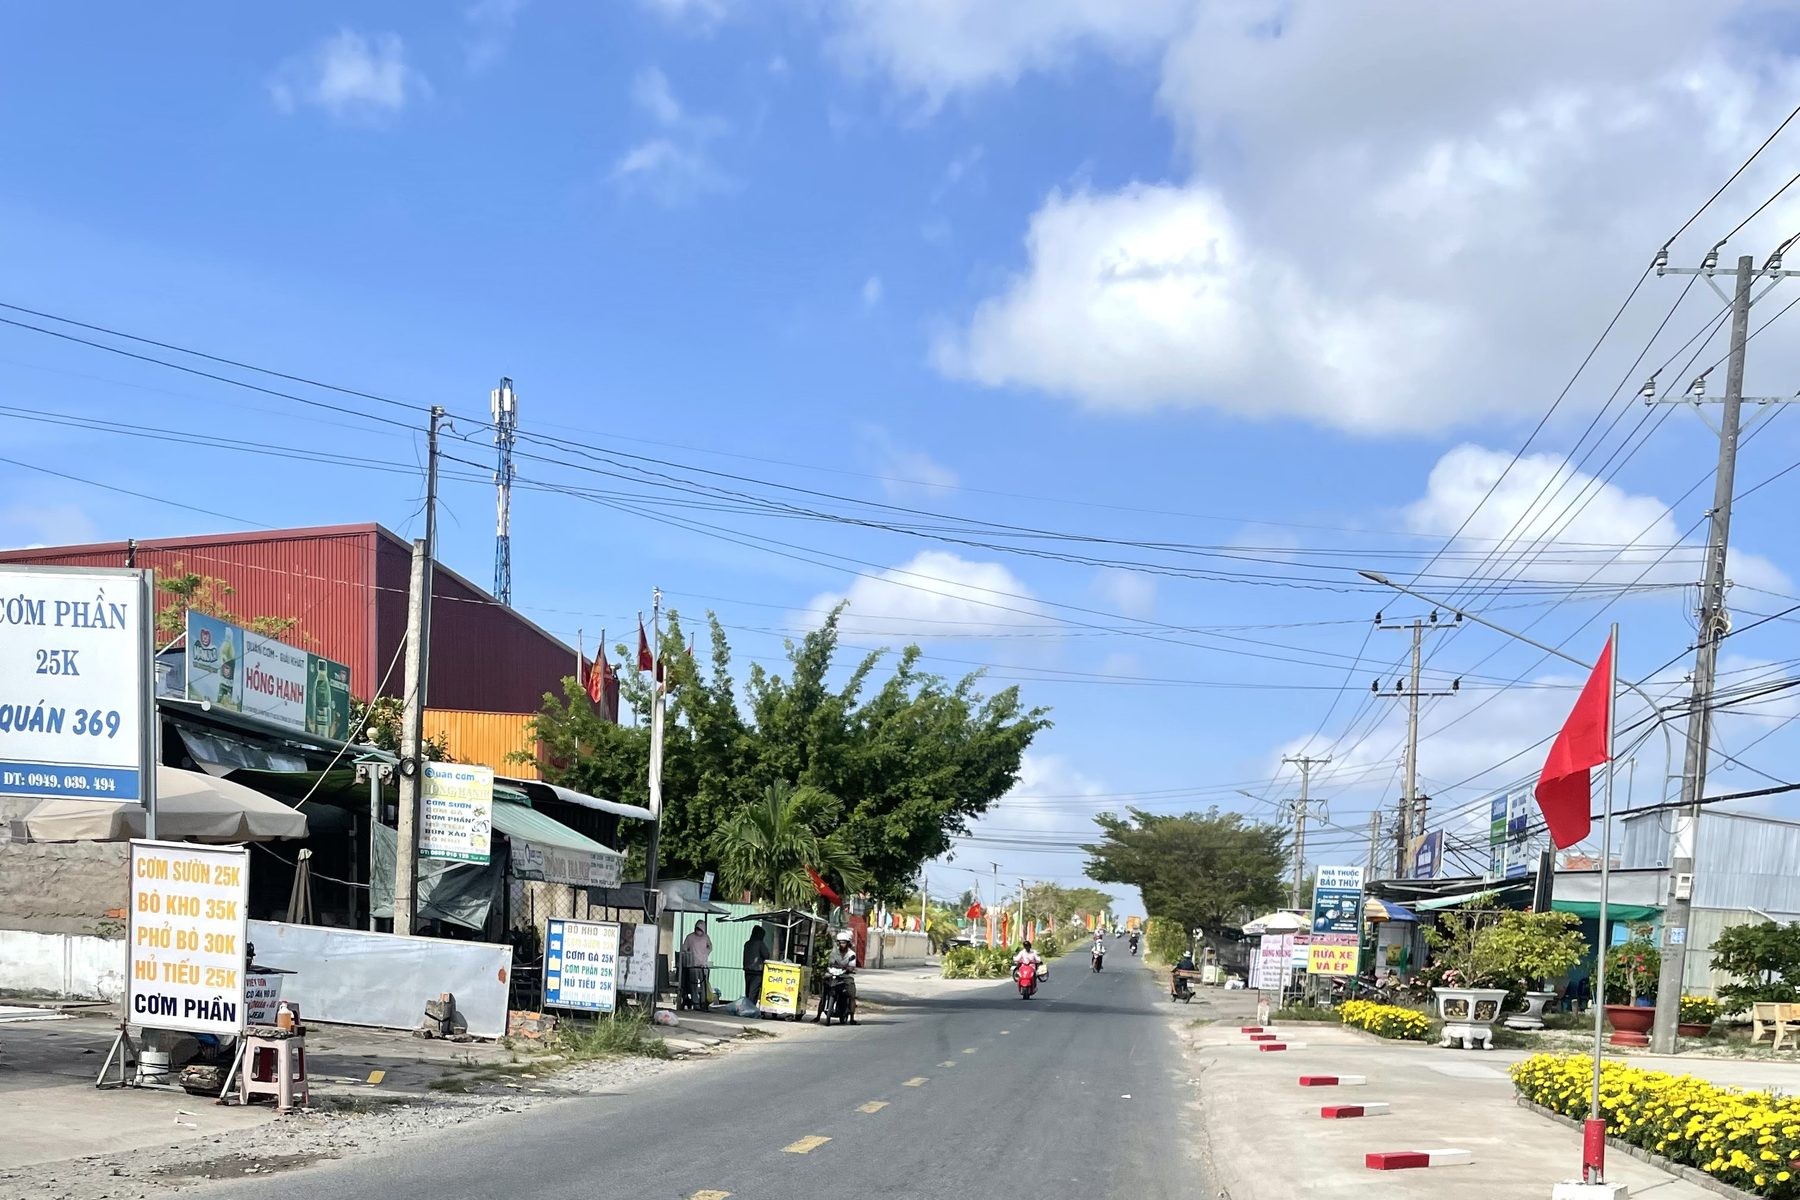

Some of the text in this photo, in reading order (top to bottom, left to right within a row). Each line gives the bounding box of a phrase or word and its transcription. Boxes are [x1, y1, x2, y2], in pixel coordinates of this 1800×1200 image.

[0, 587, 127, 630] ƠM PHẦN
[36, 649, 80, 676] 25K
[276, 678, 304, 706] HẠNH
[0, 699, 121, 739] QUÁN 369
[137, 856, 240, 887] CƠM SƯỜN 25K
[138, 889, 237, 921] BÒ KHO 35K
[137, 921, 236, 955] PHỞ BÒ 30K
[565, 950, 586, 961] CƠM
[601, 953, 614, 963] 25K
[1313, 948, 1353, 959] RỬA XE
[135, 954, 237, 989] HỦ TIẾU 25K
[564, 963, 580, 974] CƠM
[600, 967, 613, 977] 25K
[600, 981, 612, 991] 25K
[135, 992, 236, 1022] CƠM PHẦN
